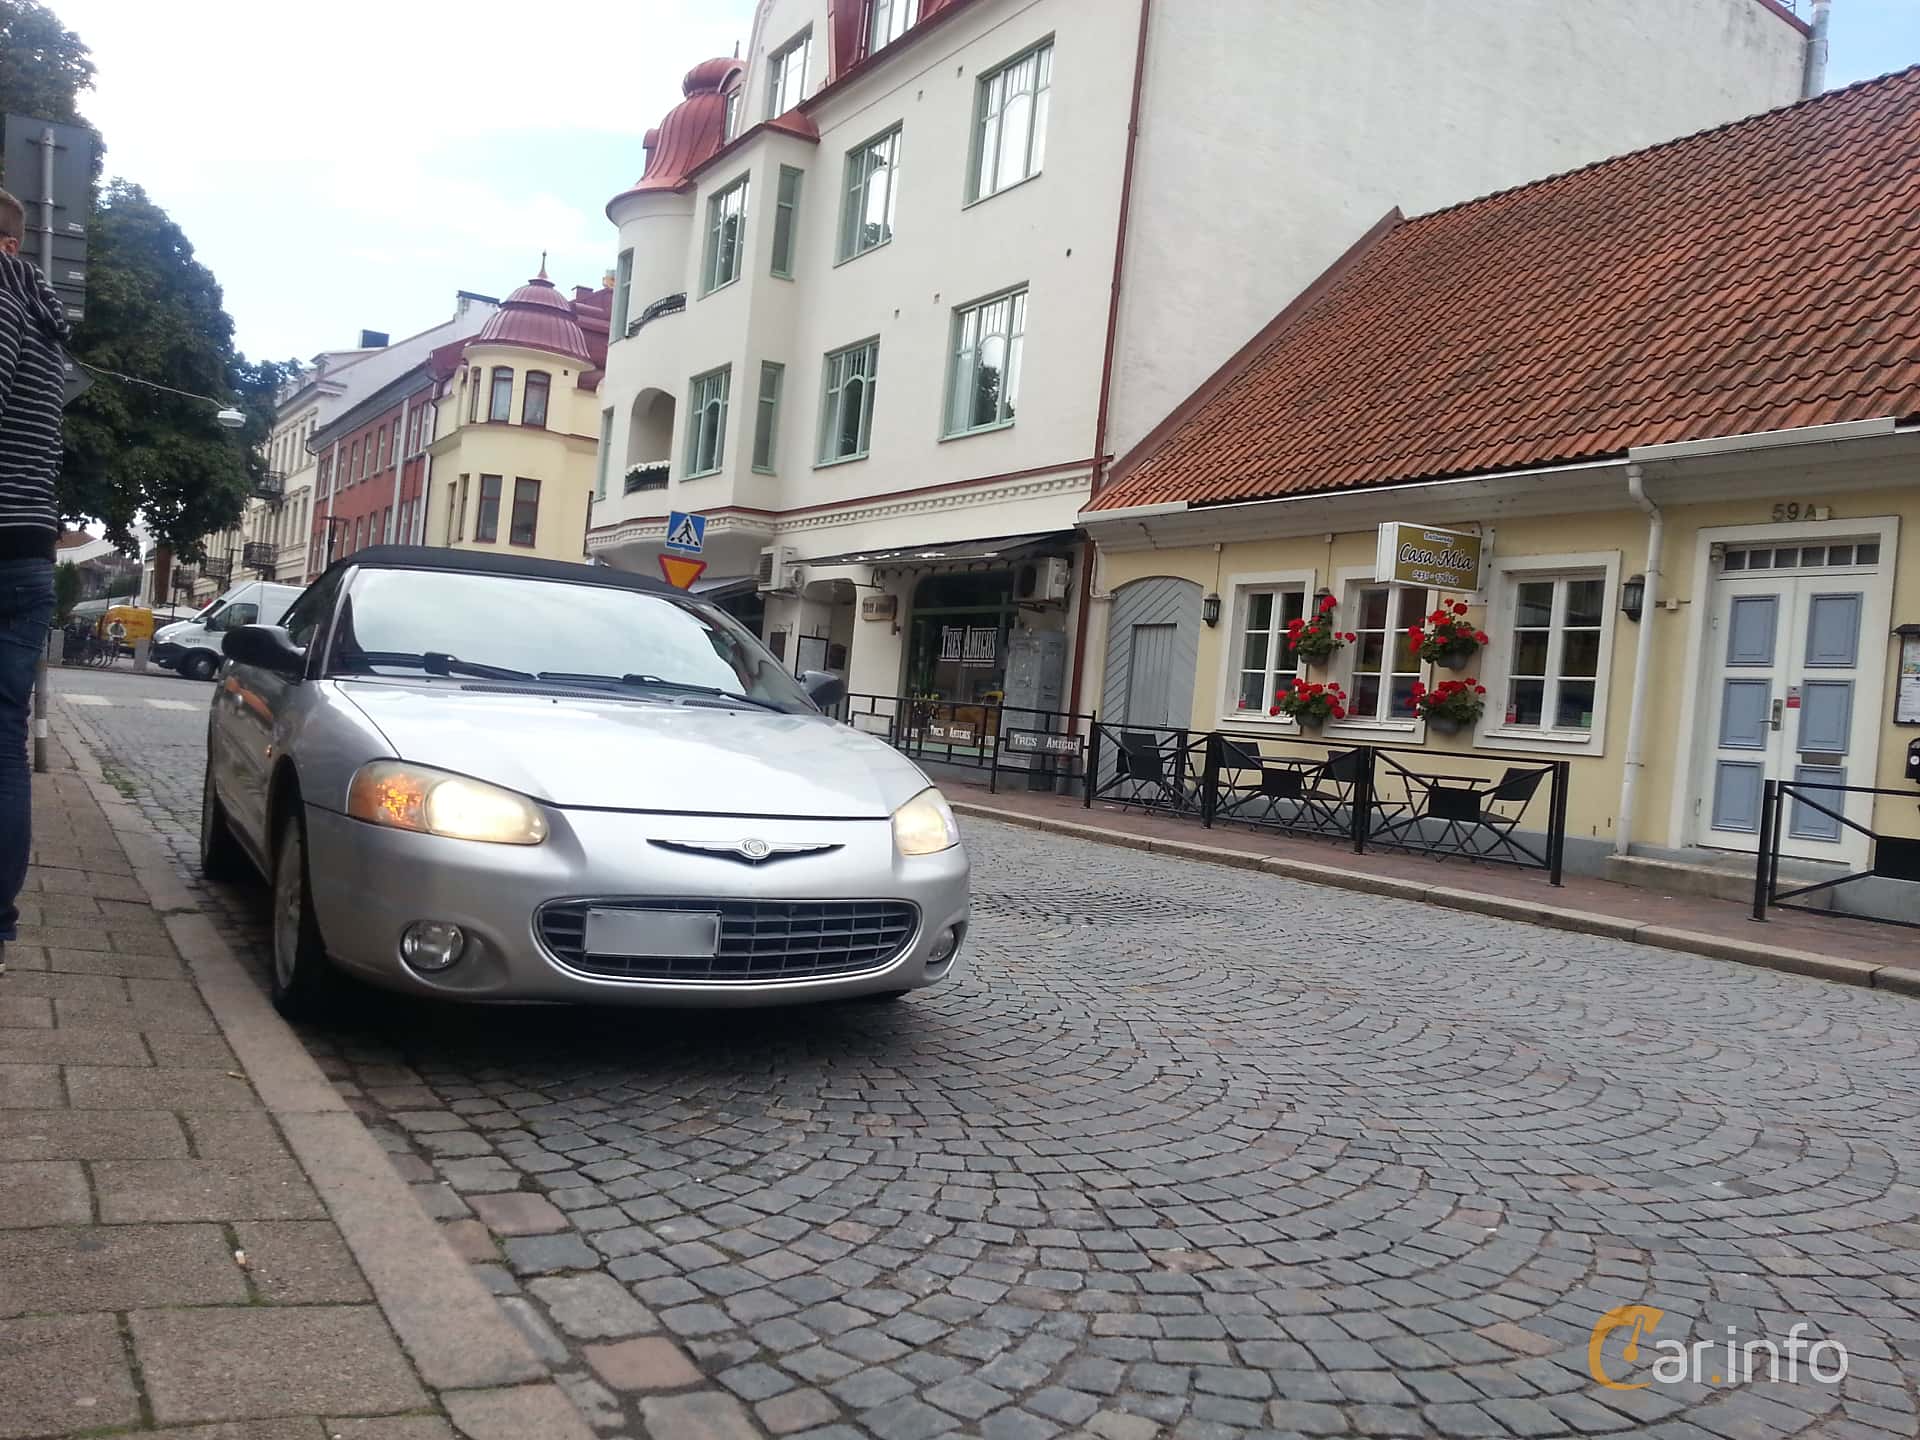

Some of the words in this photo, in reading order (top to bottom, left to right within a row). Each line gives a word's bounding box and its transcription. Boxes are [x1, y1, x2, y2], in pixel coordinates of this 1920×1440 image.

[1399, 543, 1434, 564] Casa
[1438, 548, 1474, 571] Mia
[942, 625, 962, 658] TRES
[963, 625, 997, 658] AMIGOS
